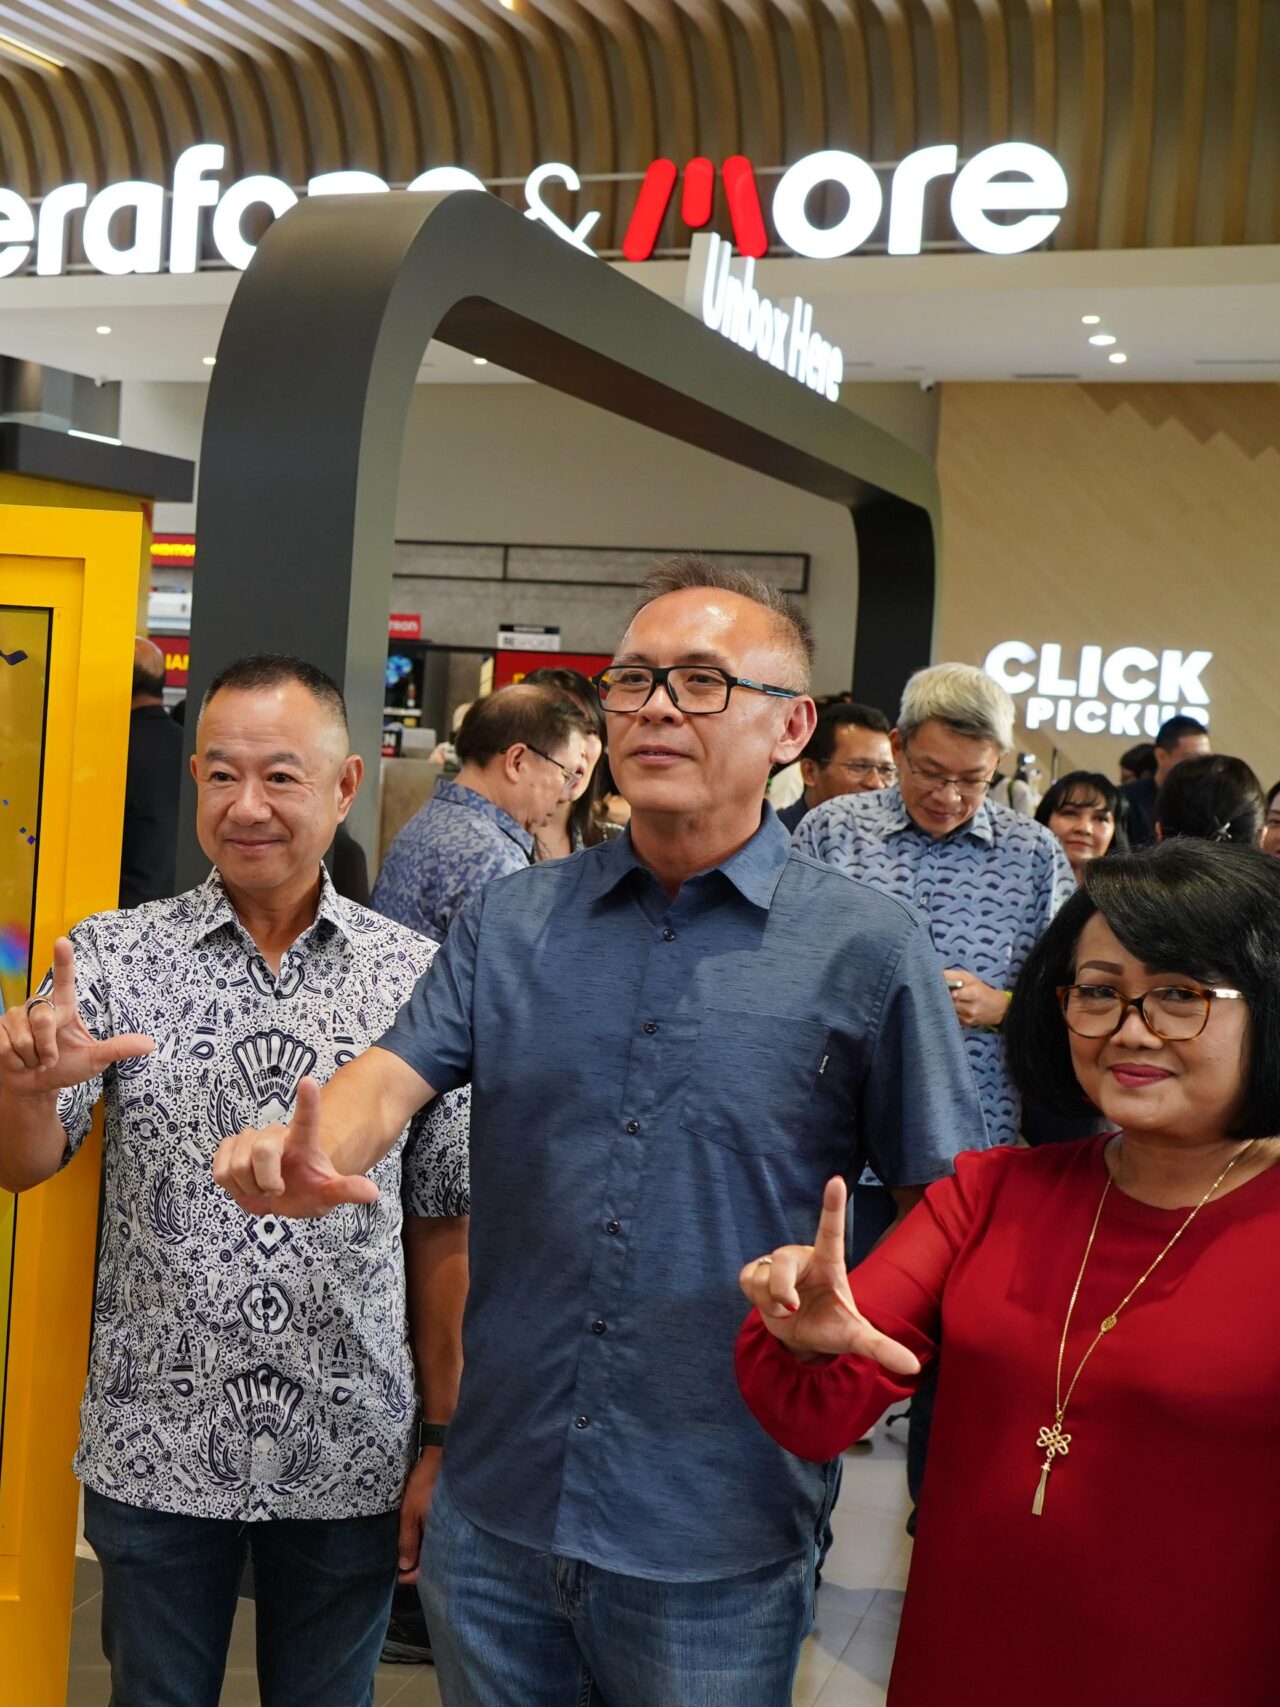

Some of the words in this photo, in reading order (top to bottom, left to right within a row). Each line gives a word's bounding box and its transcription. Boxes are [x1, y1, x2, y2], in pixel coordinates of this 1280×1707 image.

[701, 232, 789, 371] Unbox
[787, 296, 843, 402] Here
[984, 640, 1213, 705] CLICK
